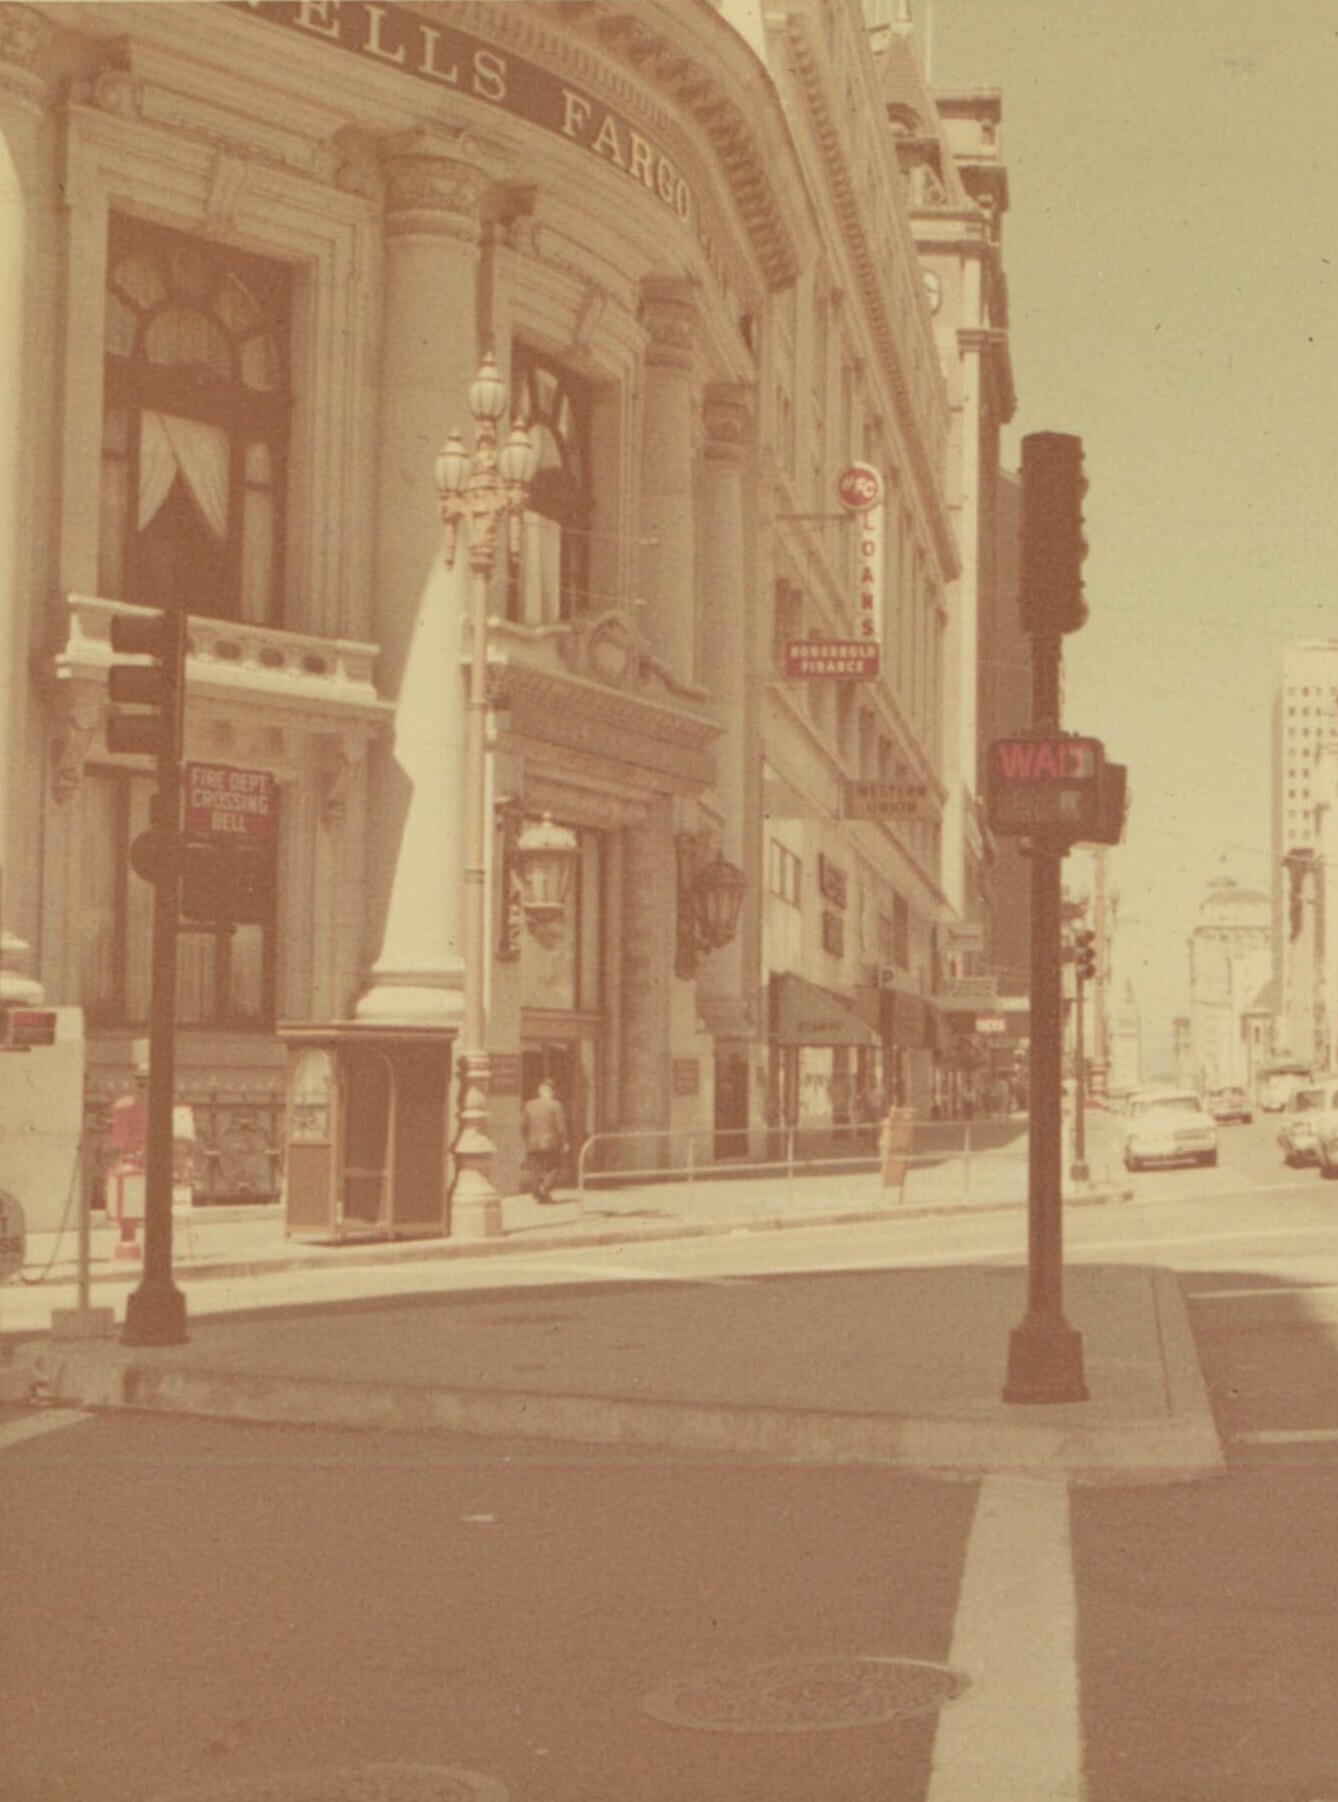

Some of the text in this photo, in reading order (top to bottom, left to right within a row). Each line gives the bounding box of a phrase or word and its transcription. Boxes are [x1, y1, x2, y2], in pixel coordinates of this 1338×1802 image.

[248, 0, 692, 223] ELLS FARGO
[861, 508, 876, 638] LOANS
[790, 645, 877, 659] HOUSEHOLD
[801, 660, 865, 674] FINANCE
[191, 768, 225, 790] FIRE
[191, 788, 269, 815] CROSSING
[856, 785, 928, 798] WESTERN
[867, 802, 918, 814] UNION
[211, 810, 248, 833] BELL
